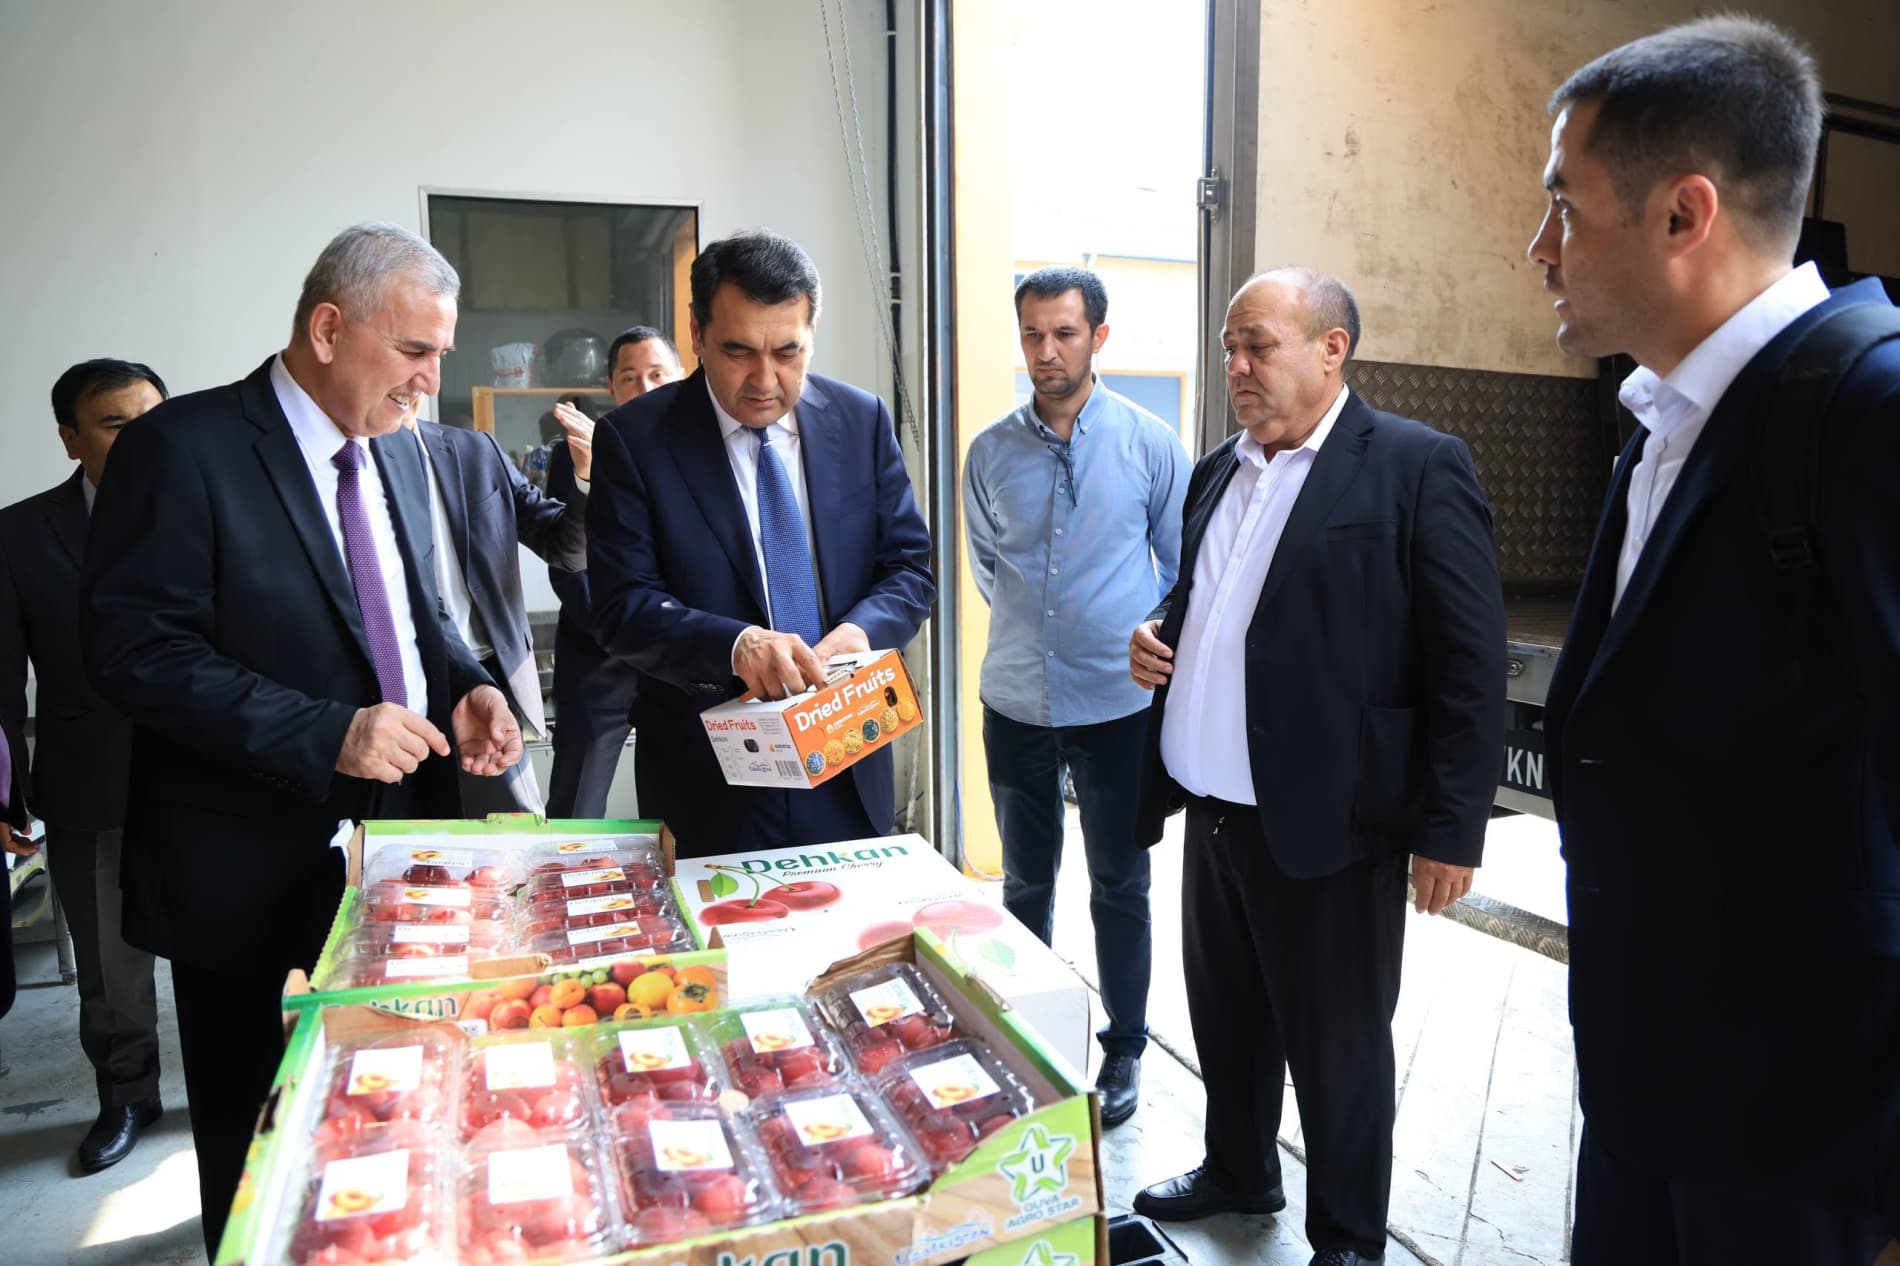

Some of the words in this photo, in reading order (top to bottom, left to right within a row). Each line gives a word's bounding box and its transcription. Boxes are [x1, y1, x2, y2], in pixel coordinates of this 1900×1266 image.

[795, 694, 843, 732] Dried
[843, 667, 895, 704] Fruits
[704, 720, 729, 732] Dried
[729, 719, 757, 731] Fruits
[1504, 745, 1544, 790] KN
[741, 846, 908, 874] Dehkan
[782, 867, 836, 877] Premium
[1031, 1153, 1044, 1173] U
[1008, 1210, 1044, 1229] AGRO
[1047, 1197, 1080, 1216] STAR
